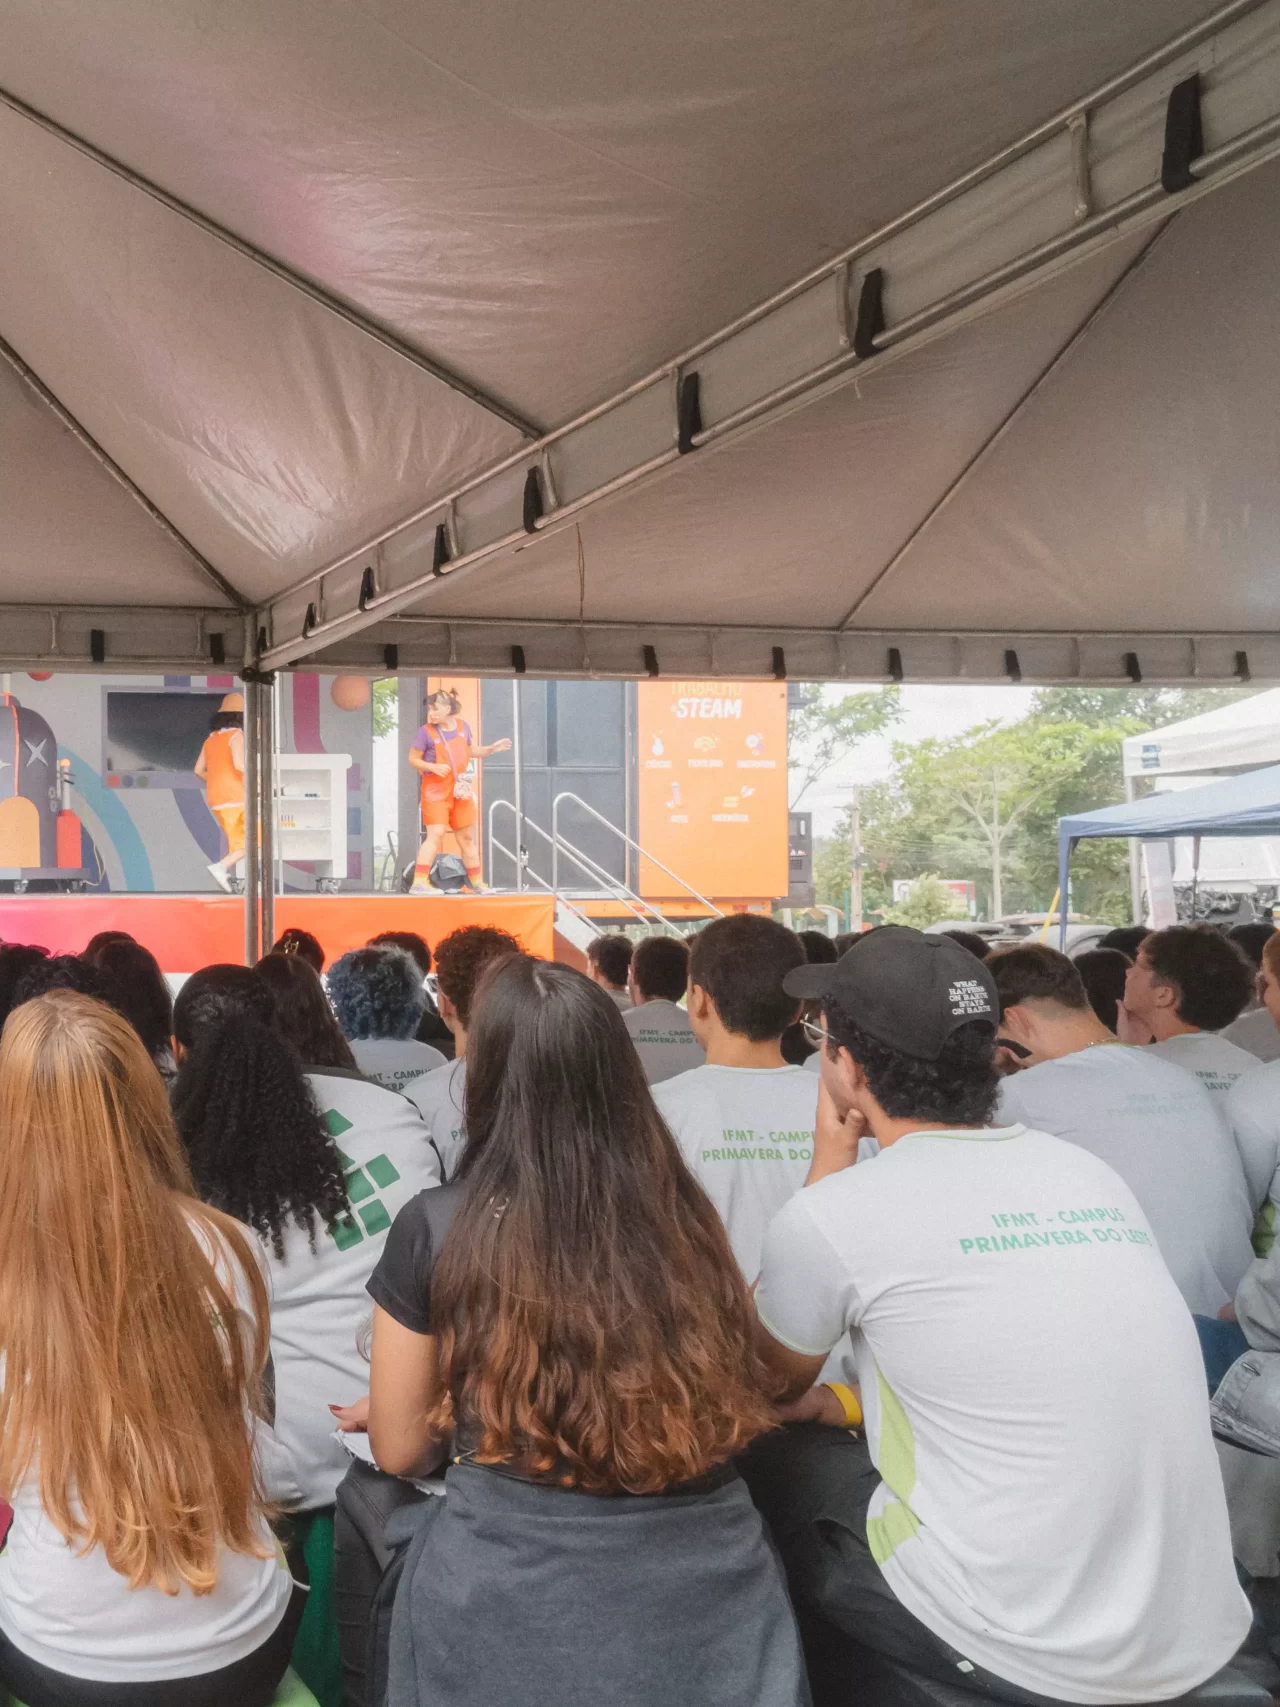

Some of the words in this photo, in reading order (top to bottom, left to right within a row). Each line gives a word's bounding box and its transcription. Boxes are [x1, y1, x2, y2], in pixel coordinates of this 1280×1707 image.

[676, 697, 742, 718] STEAM
[953, 980, 977, 988] WHAT
[959, 999, 984, 1008] STAYS
[952, 1007, 965, 1015] ON
[722, 1129, 754, 1141] IFMT
[702, 1148, 783, 1162] PRIMAVERA
[788, 1148, 812, 1160] DO
[991, 1212, 1040, 1228] IFMT
[1058, 1207, 1125, 1224] CAMPUS
[959, 1230, 1092, 1254] PRIMAVERA
[1092, 1228, 1122, 1242] DO
